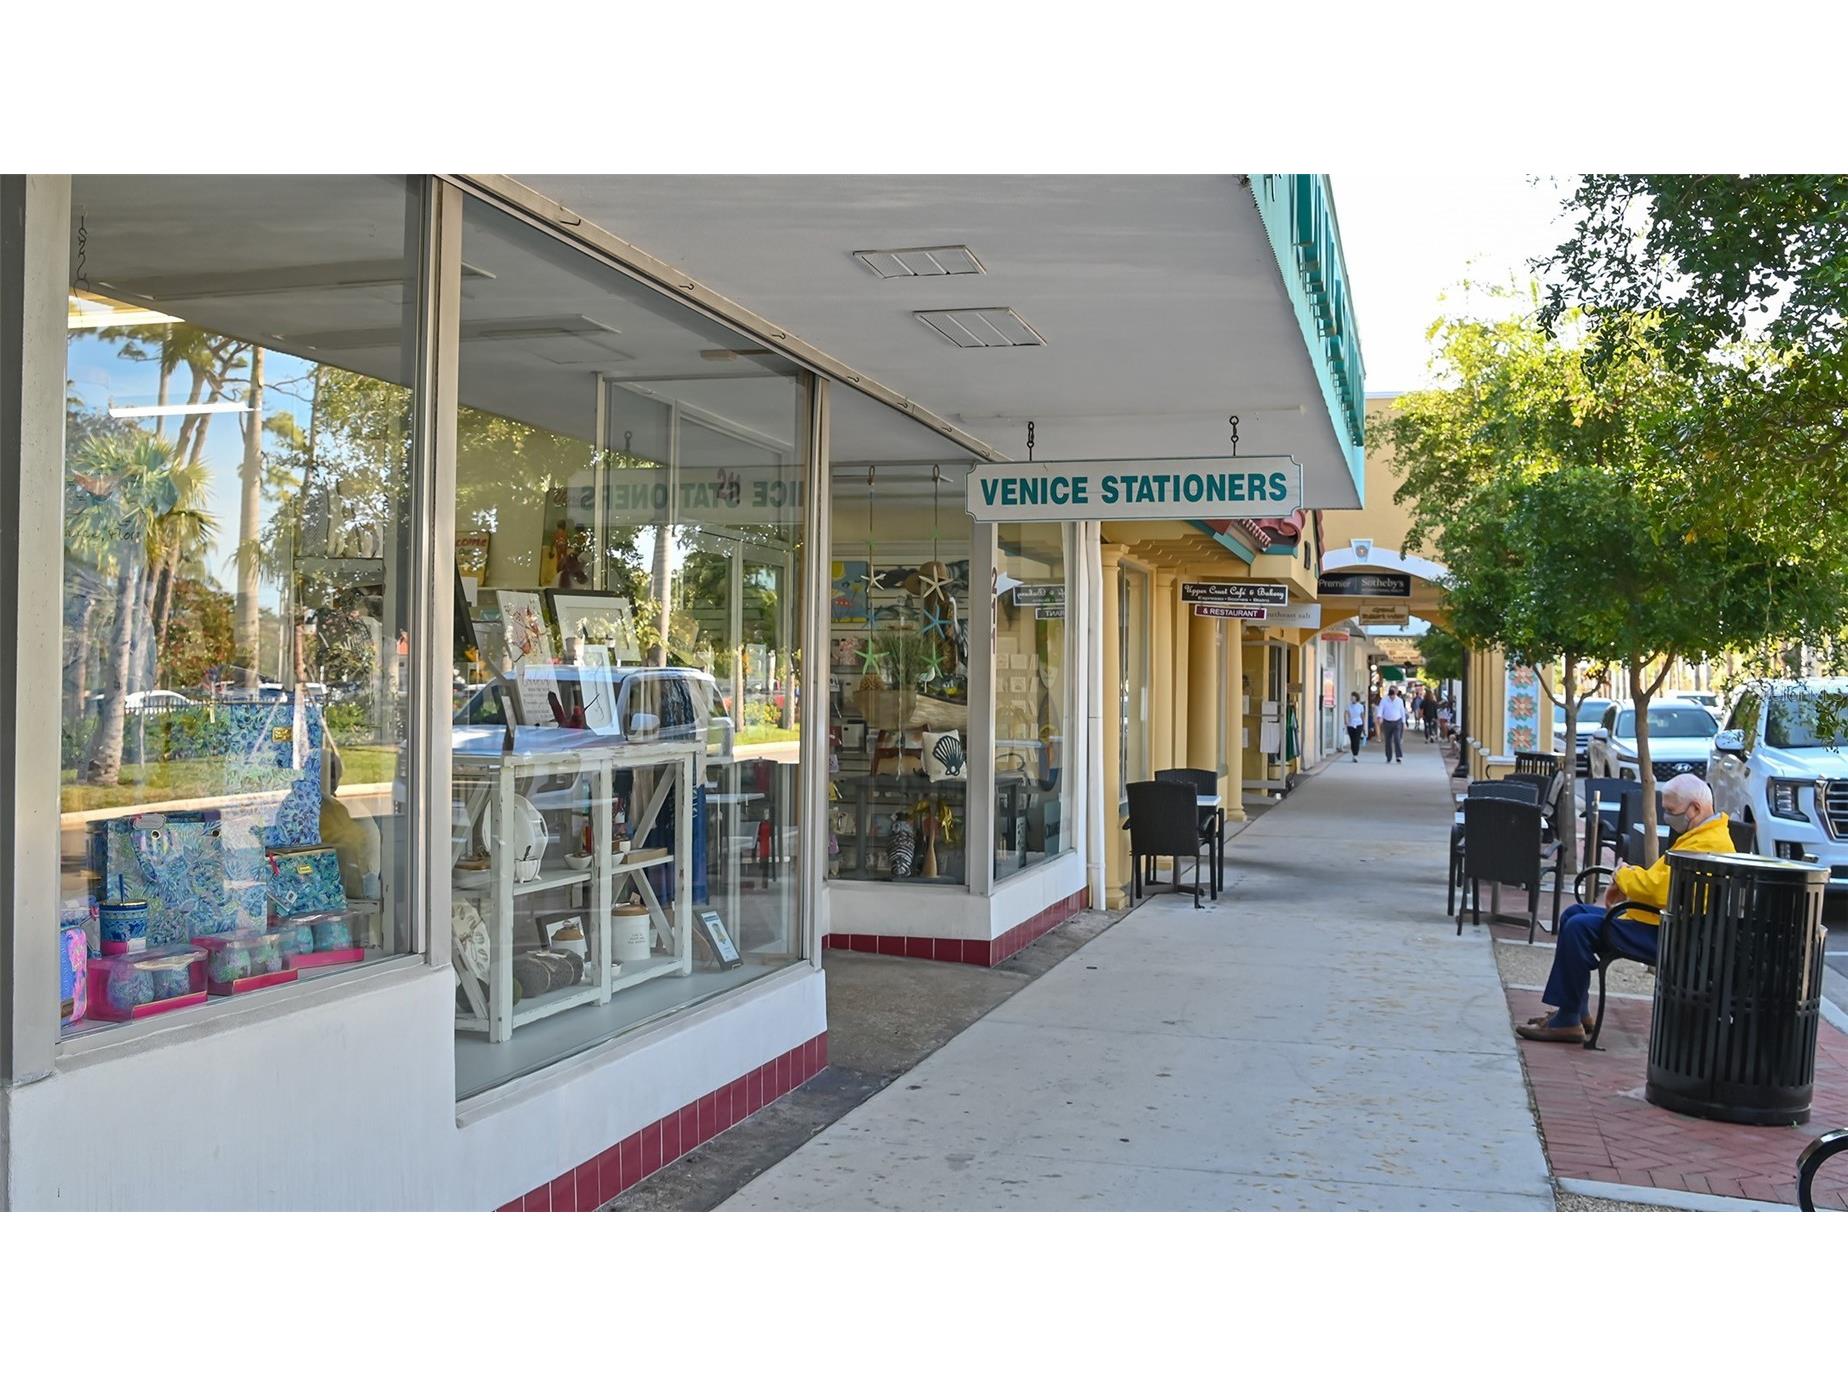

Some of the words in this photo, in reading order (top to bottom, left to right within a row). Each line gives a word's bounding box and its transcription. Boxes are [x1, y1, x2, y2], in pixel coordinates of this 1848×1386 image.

[981, 476, 1088, 505] VENICE
[1101, 472, 1287, 504] STATIONERS
[1318, 579, 1351, 588] Premier
[1361, 577, 1404, 589] Sotheby's
[1184, 584, 1207, 596] Upper
[1209, 585, 1228, 595] Crust
[1230, 586, 1246, 598] Café
[1257, 587, 1284, 599] Bakery
[1210, 608, 1258, 617] RESTAURANT
